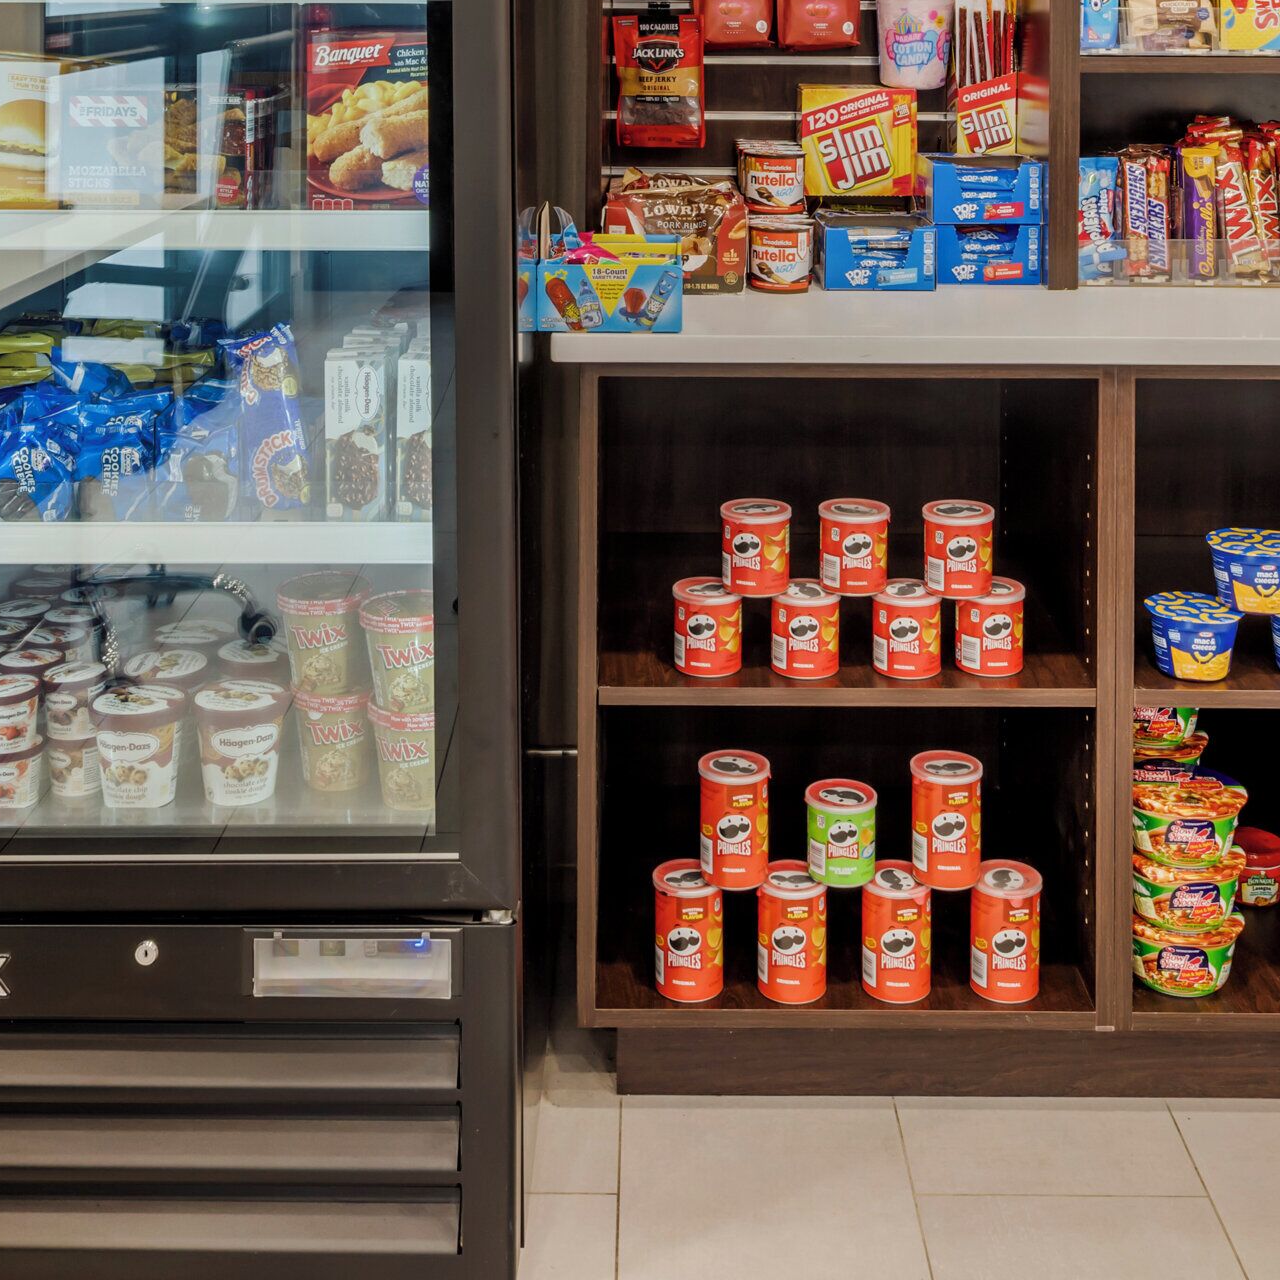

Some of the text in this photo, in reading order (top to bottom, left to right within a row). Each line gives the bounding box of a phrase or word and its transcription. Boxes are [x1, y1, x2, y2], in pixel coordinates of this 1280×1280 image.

[650, 23, 679, 31] CALORIES
[315, 44, 384, 66] Banquet
[397, 49, 424, 57] Chicken
[893, 42, 932, 53] COTTON
[896, 54, 929, 65] CANDY
[962, 83, 1010, 103] ORIGINAL
[840, 93, 889, 113] ORIGINAL
[86, 107, 138, 117] FRIDAYS
[806, 108, 839, 131] 120
[69, 178, 111, 188] STICKS
[751, 174, 795, 186] nutella
[1128, 164, 1147, 234] SNICKERS
[657, 220, 707, 229] PORK RINDS
[1148, 198, 1167, 268] SNICKERS
[1199, 202, 1214, 277] Caramello
[752, 249, 796, 262] nutella
[19, 447, 35, 493] COOKIES
[110, 447, 118, 496] COOKIES
[732, 555, 760, 570] PRINGLES
[843, 555, 872, 570] PRINGLES
[946, 559, 977, 573] PRINGLES
[687, 638, 716, 652] PRINGLES
[788, 638, 818, 653] PRINGLES
[889, 640, 919, 654] PRINGLES
[982, 637, 1012, 651] PRINGLES
[717, 840, 752, 856] PRINGLES
[828, 844, 859, 858] PRINGLES
[932, 838, 966, 854] PRINGLES
[668, 953, 702, 969] PRINGLES
[772, 953, 806, 968] PRINGLES
[881, 954, 915, 970] PRINGLES
[992, 954, 1027, 971] PRINGLES
